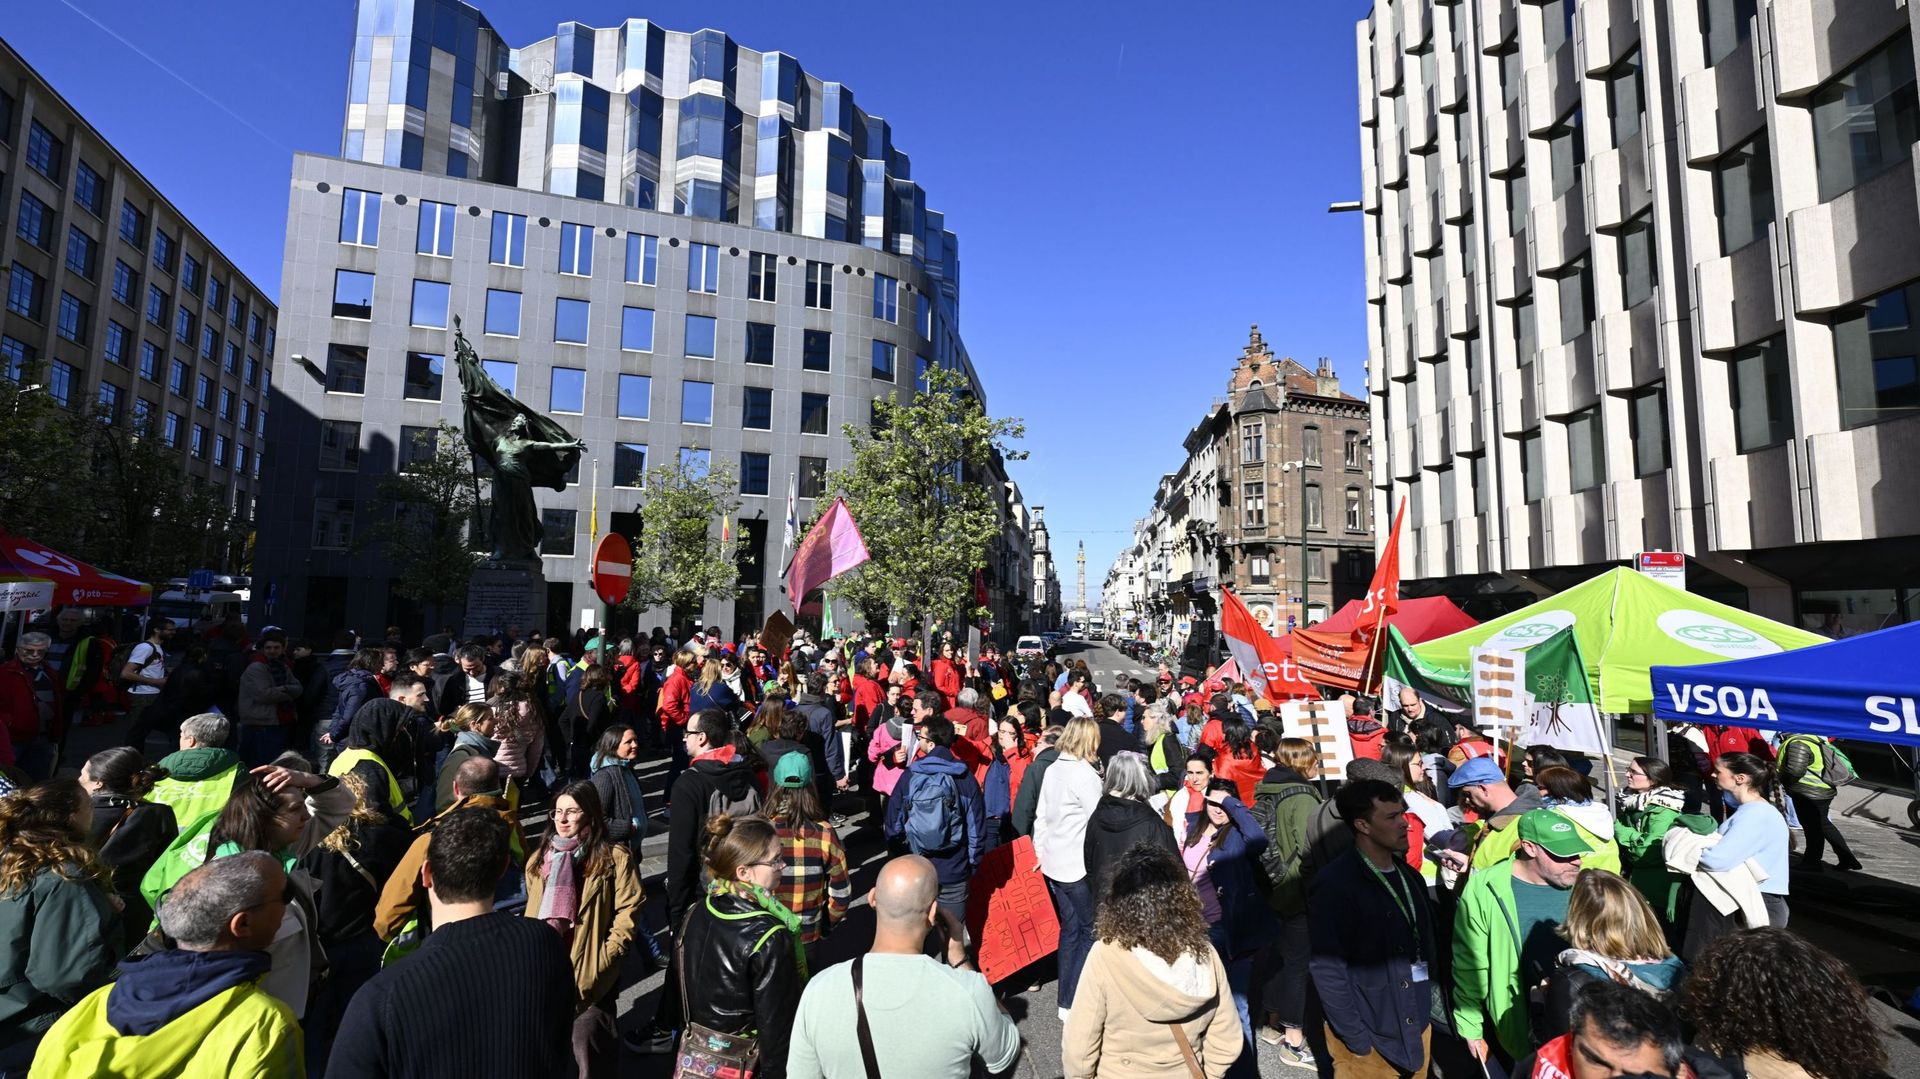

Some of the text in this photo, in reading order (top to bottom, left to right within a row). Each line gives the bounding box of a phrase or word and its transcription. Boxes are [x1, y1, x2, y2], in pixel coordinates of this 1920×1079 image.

[1504, 624, 1558, 637] CSC
[1678, 626, 1755, 642] CSC
[1666, 683, 1779, 721] VSOA
